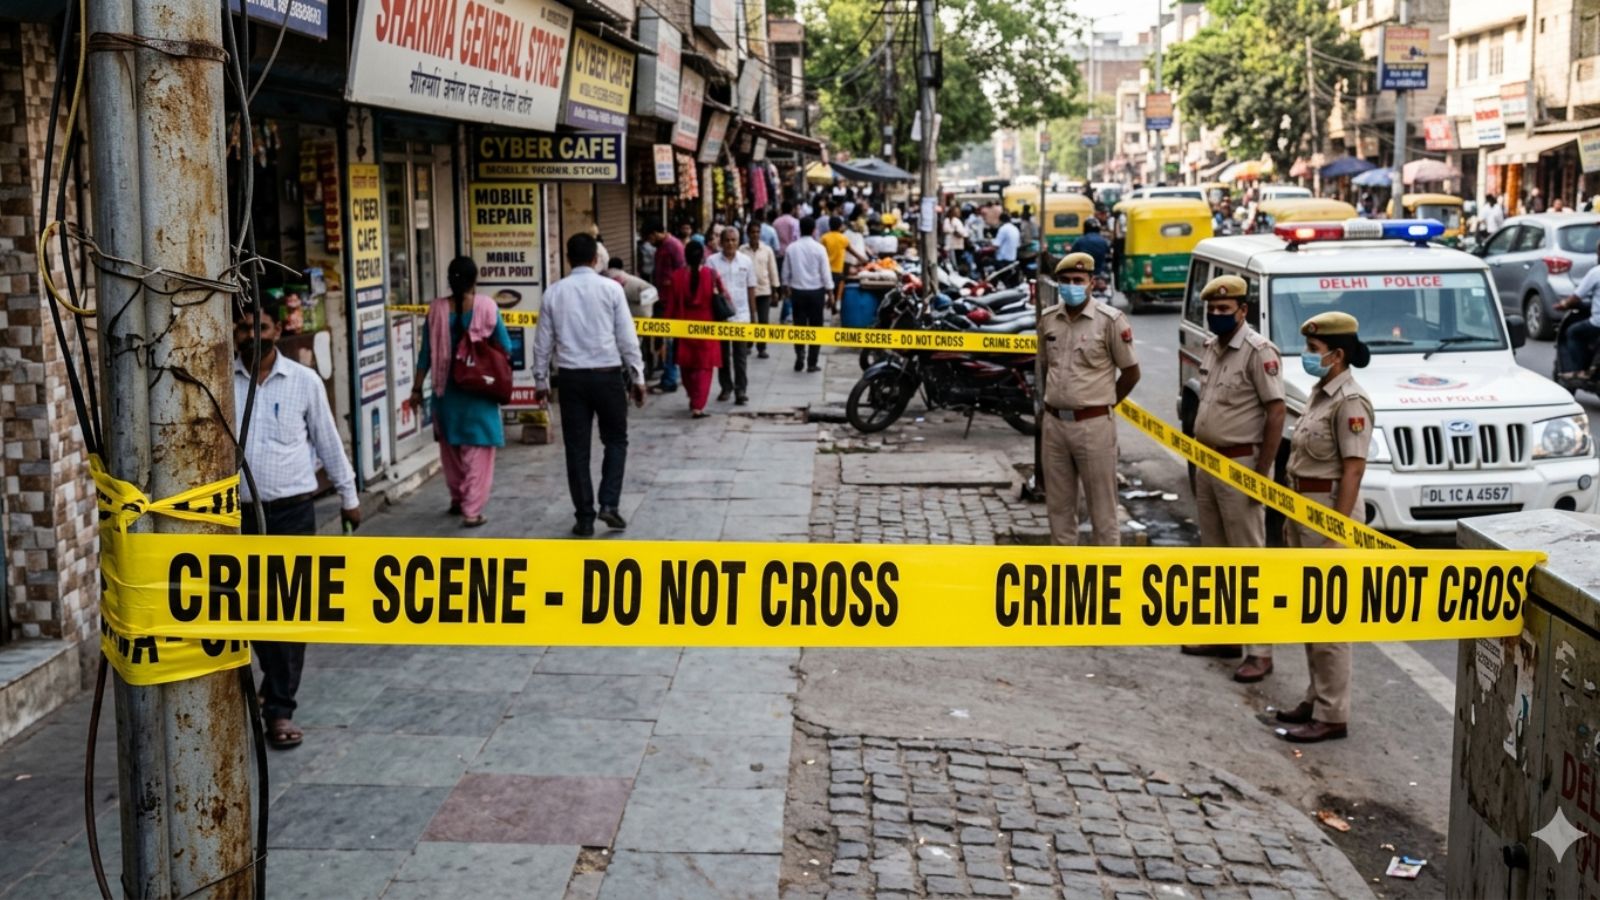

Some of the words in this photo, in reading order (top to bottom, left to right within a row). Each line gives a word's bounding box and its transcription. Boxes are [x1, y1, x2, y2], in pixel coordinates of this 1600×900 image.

[376, 0, 457, 61] SHARMA
[460, 0, 525, 79] GENERAL
[526, 26, 566, 89] STORE
[480, 136, 553, 159] CYBER
[559, 137, 616, 160] CAFE
[475, 188, 534, 206] MOBILE
[477, 208, 533, 225] REPAIR
[1319, 277, 1368, 289] DELHI
[1383, 275, 1443, 287] POLICE
[688, 324, 715, 336] CRIME
[834, 331, 862, 344] CRIME
[915, 335, 932, 346] NOT
[982, 336, 1011, 349] CRIME
[1429, 488, 1446, 502] DL
[168, 552, 346, 622] CRIME
[372, 554, 528, 624] SCENE
[545, 592, 563, 605] -
[582, 558, 642, 625] DO
[660, 559, 746, 626] NOT
[762, 560, 899, 627] CROSS
[995, 563, 1121, 627] CRIME
[1142, 564, 1259, 626] SCENE
[1274, 595, 1286, 608] -
[1302, 565, 1348, 625] DO
[1361, 565, 1428, 624] NOT
[1438, 564, 1534, 623] CROS
